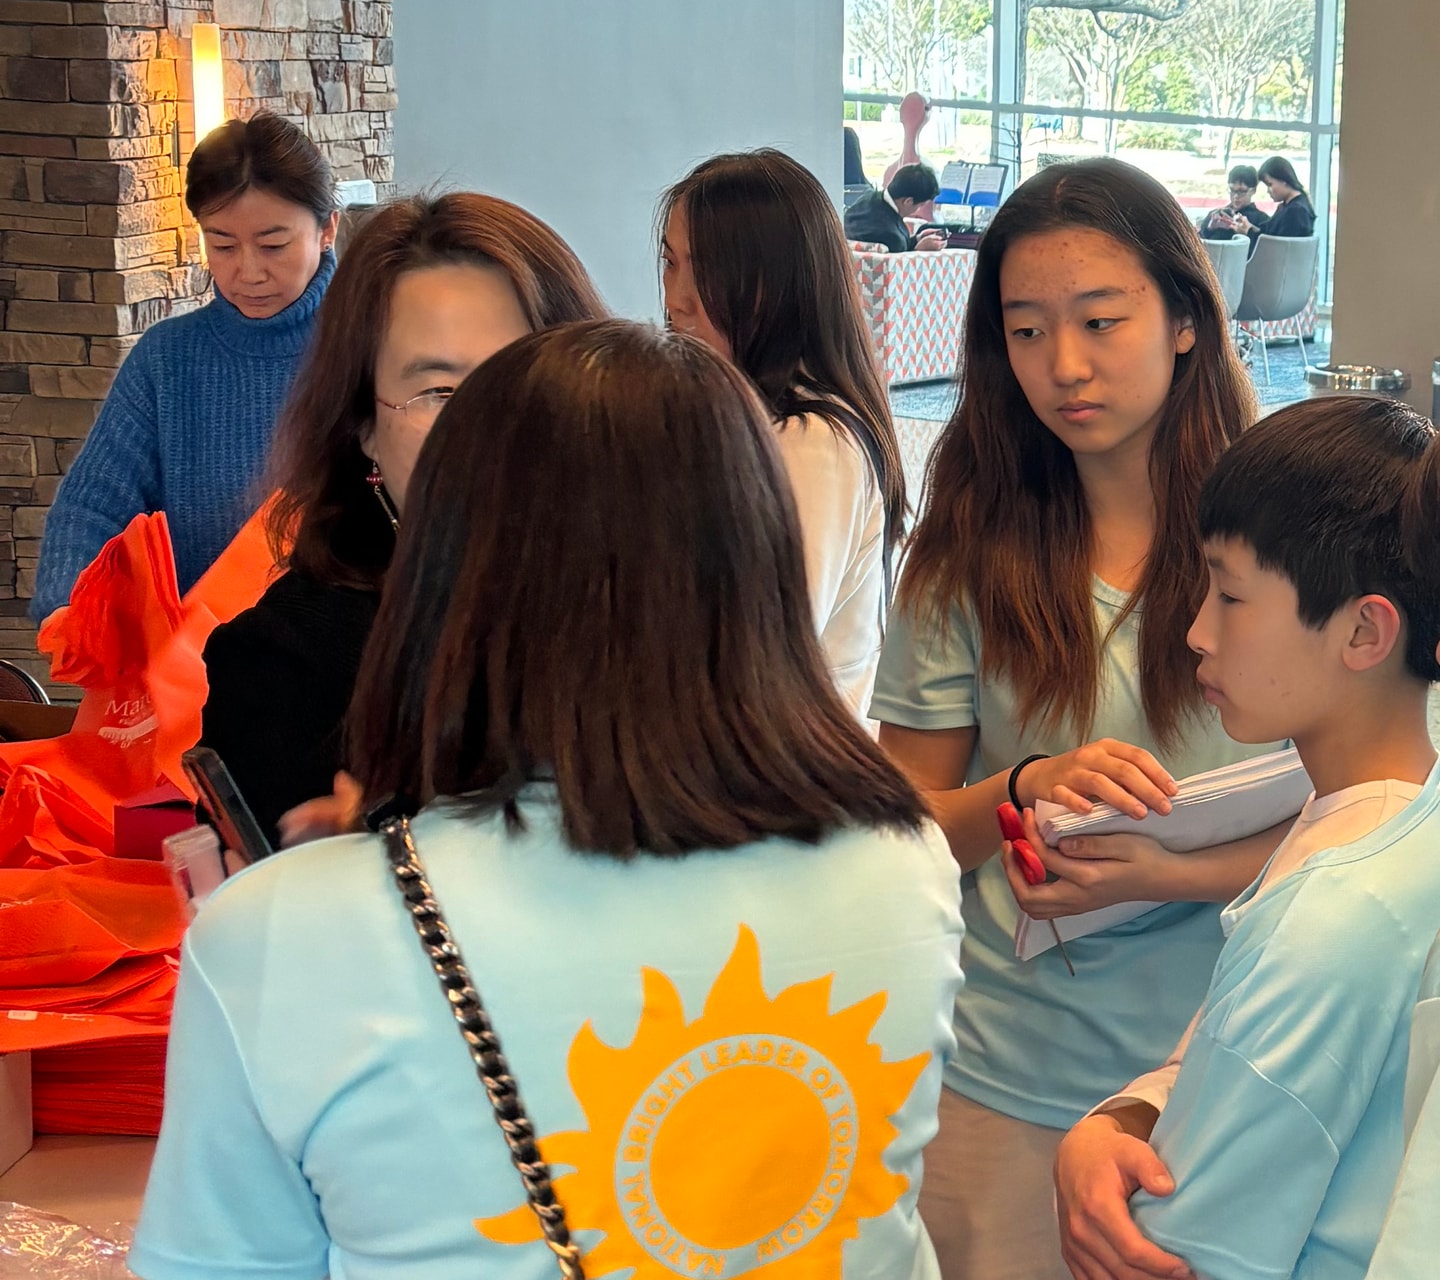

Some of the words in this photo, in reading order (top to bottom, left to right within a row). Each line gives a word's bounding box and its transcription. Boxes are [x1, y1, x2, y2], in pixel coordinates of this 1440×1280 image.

[700, 1039, 809, 1073] LEADER
[810, 1067, 843, 1099] OF
[623, 1060, 696, 1162] BRIGHT
[622, 1170, 726, 1276] NATIONAL
[757, 1103, 852, 1261] TOMORROW
